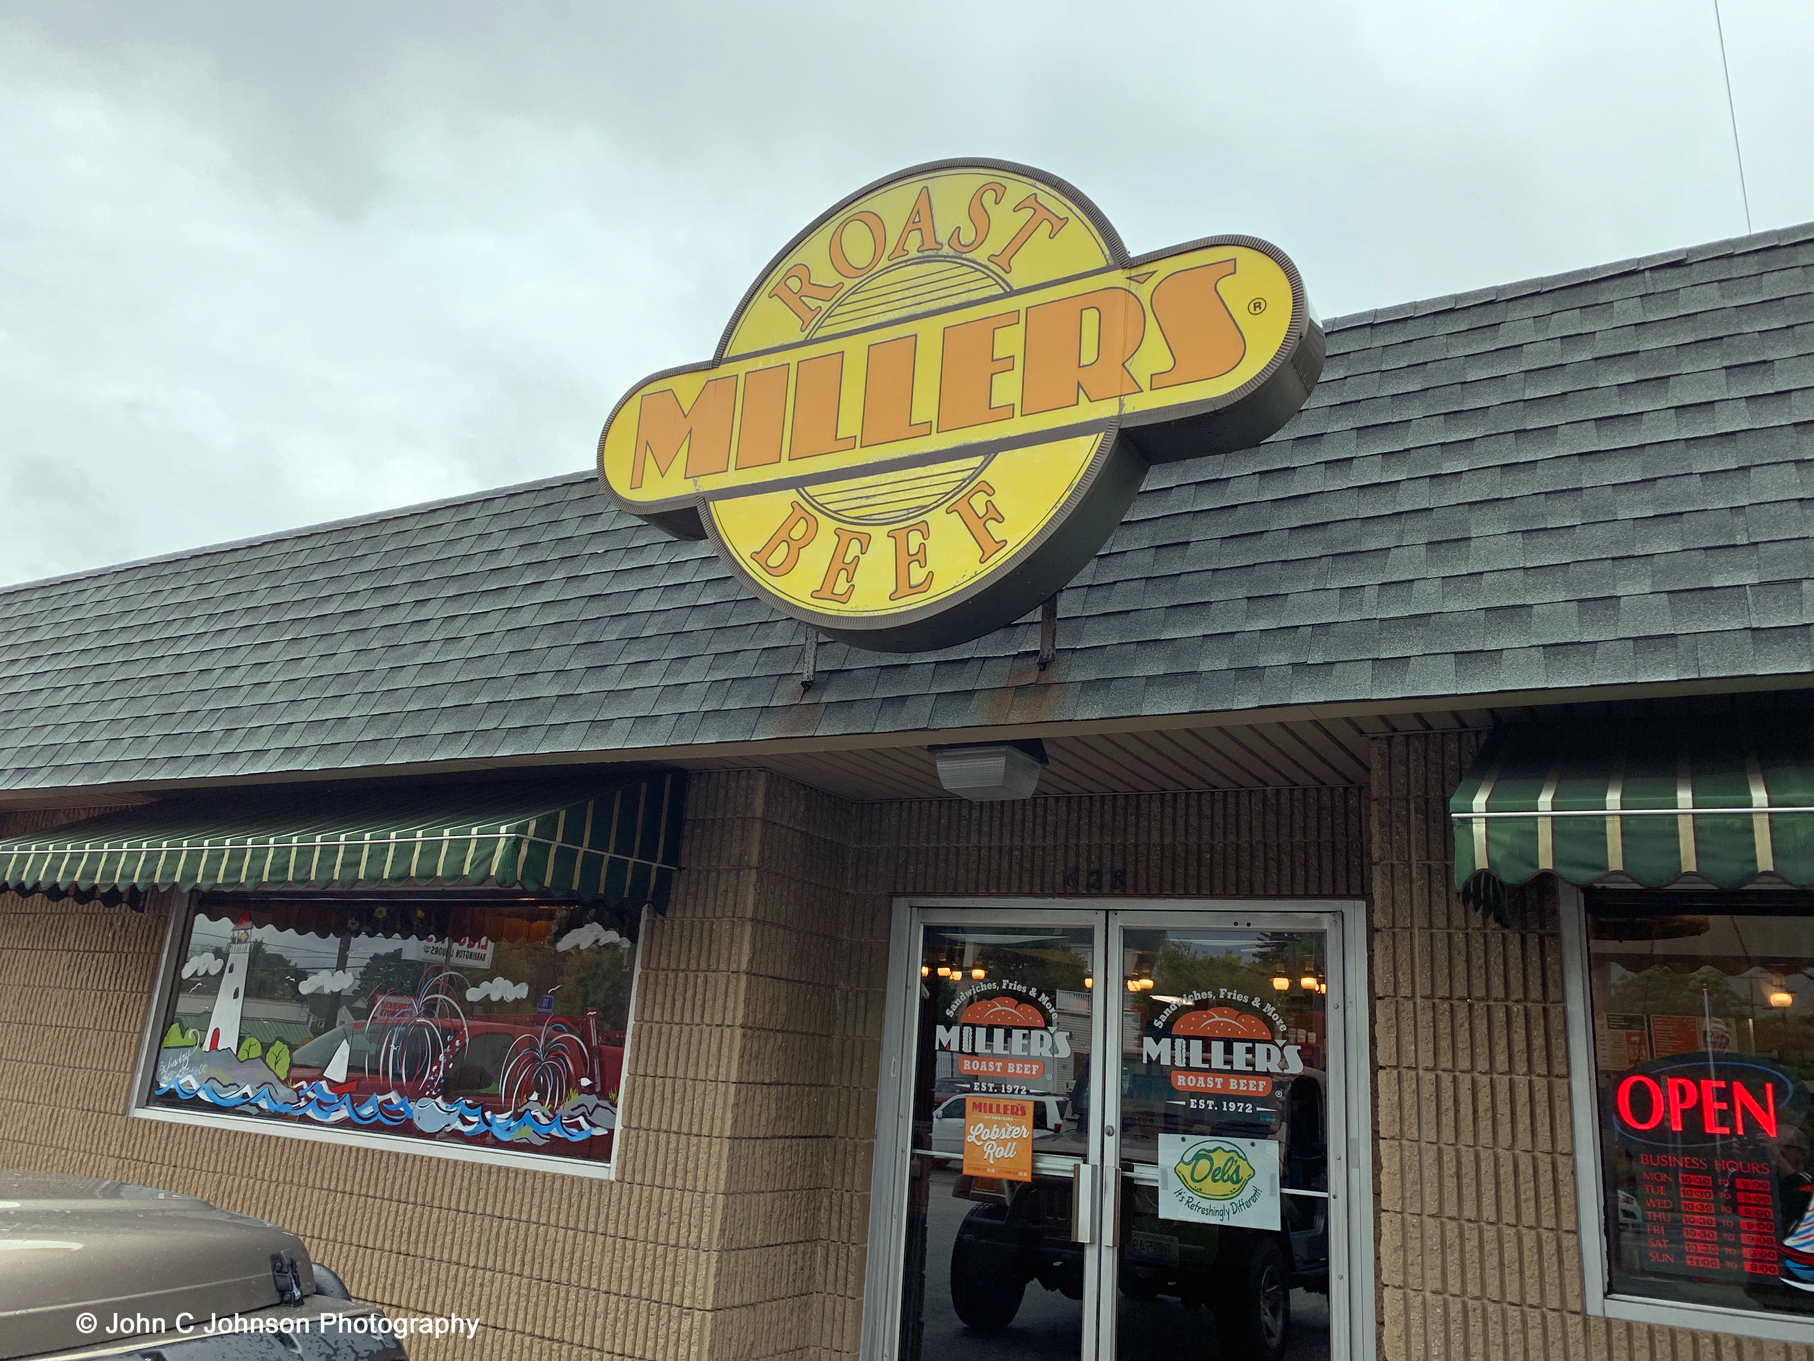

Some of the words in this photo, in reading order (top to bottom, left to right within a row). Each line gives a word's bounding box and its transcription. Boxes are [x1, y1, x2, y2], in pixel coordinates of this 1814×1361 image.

[769, 183, 1068, 331] ROAST
[752, 480, 1008, 605] BEEF
[945, 982, 1000, 1018] Sandwiches,
[1001, 979, 1028, 994] Fries
[1029, 987, 1038, 998] &
[1038, 993, 1059, 1020] More
[1219, 988, 1249, 1004] Fries
[1251, 996, 1261, 1009] &
[1262, 1002, 1287, 1032] More
[963, 1060, 1002, 1072] ROAST
[1007, 1063, 1039, 1075] BEEF
[973, 1082, 998, 1093] EST.
[1001, 1084, 1027, 1095] 1972
[1177, 1075, 1223, 1089] ROAST
[1229, 1078, 1266, 1092] BEEF
[1189, 1099, 1218, 1111] EST.
[1222, 1101, 1253, 1113] 1972
[1617, 1074, 1778, 1138] OPEN
[967, 1122, 1030, 1146] Lobster
[983, 1140, 1017, 1164] Roll
[1190, 1153, 1243, 1185] Del's
[1640, 1153, 1708, 1170] BUSINESS
[1714, 1160, 1770, 1175] HOURS
[1642, 1172, 1672, 1182] MON
[1644, 1184, 1666, 1195] TUE
[1173, 1188, 1186, 1203] It's
[1184, 1195, 1231, 1222] Refreshingly
[1230, 1185, 1263, 1215] Different!
[1645, 1199, 1673, 1209] WED
[1646, 1211, 1672, 1222] THU
[1647, 1224, 1664, 1235] FRI
[1648, 1238, 1668, 1249] SAT
[1649, 1251, 1674, 1263] SUN
